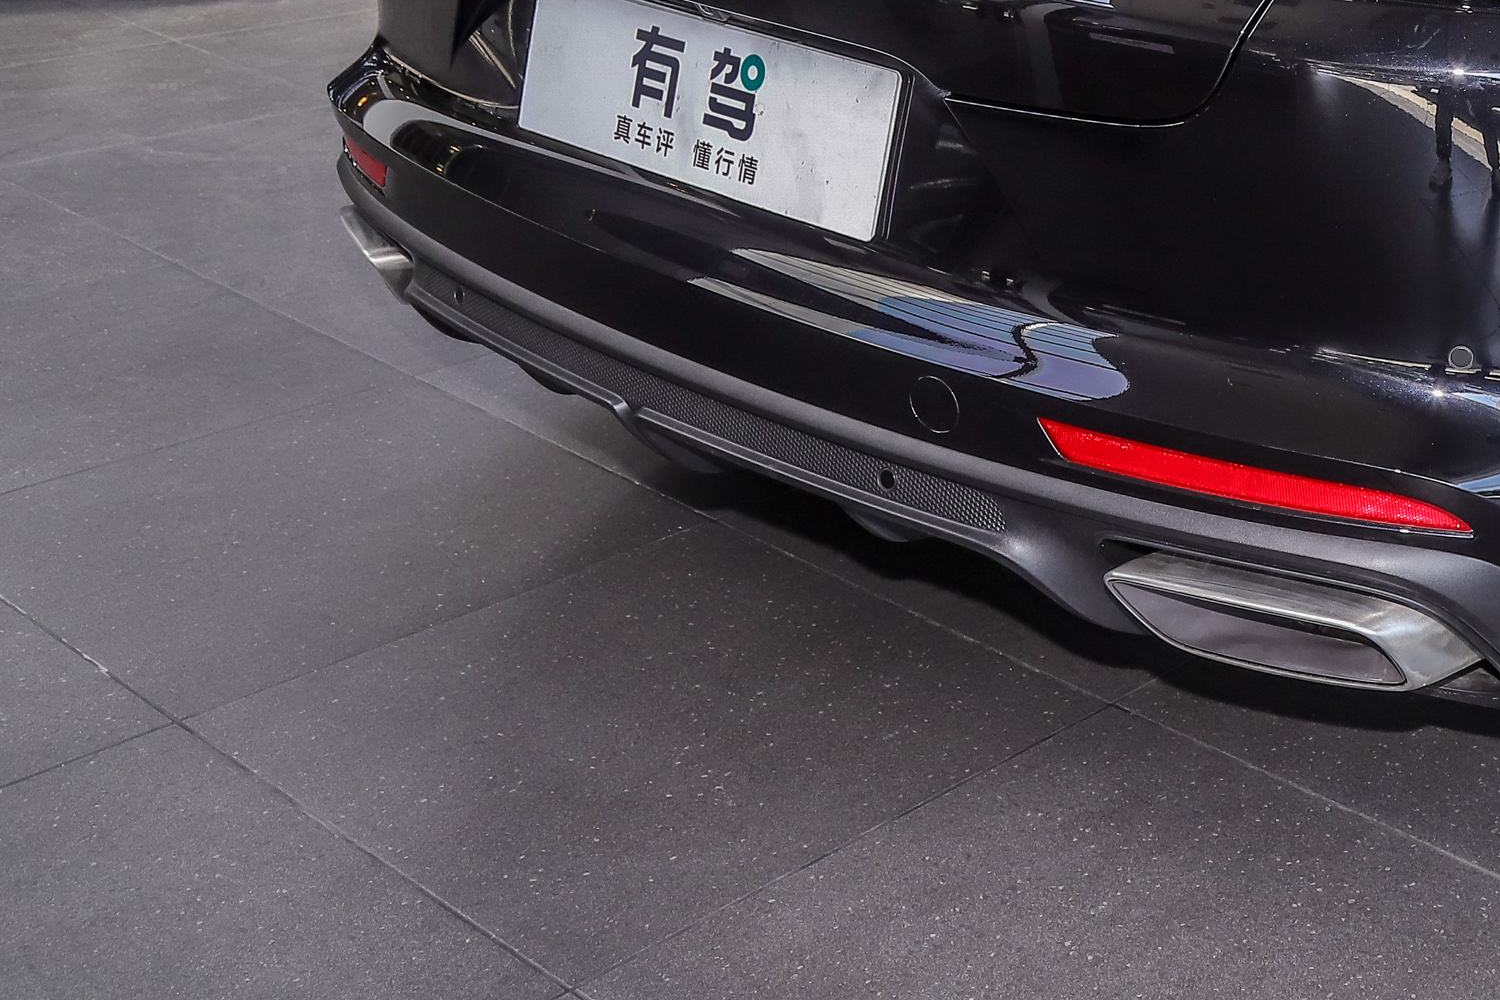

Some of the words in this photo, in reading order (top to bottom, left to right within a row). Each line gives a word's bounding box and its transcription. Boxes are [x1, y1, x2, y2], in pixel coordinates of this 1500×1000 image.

[630, 24, 766, 142] 有驾
[612, 114, 675, 158] 真车评
[692, 139, 760, 186] 懂行情
